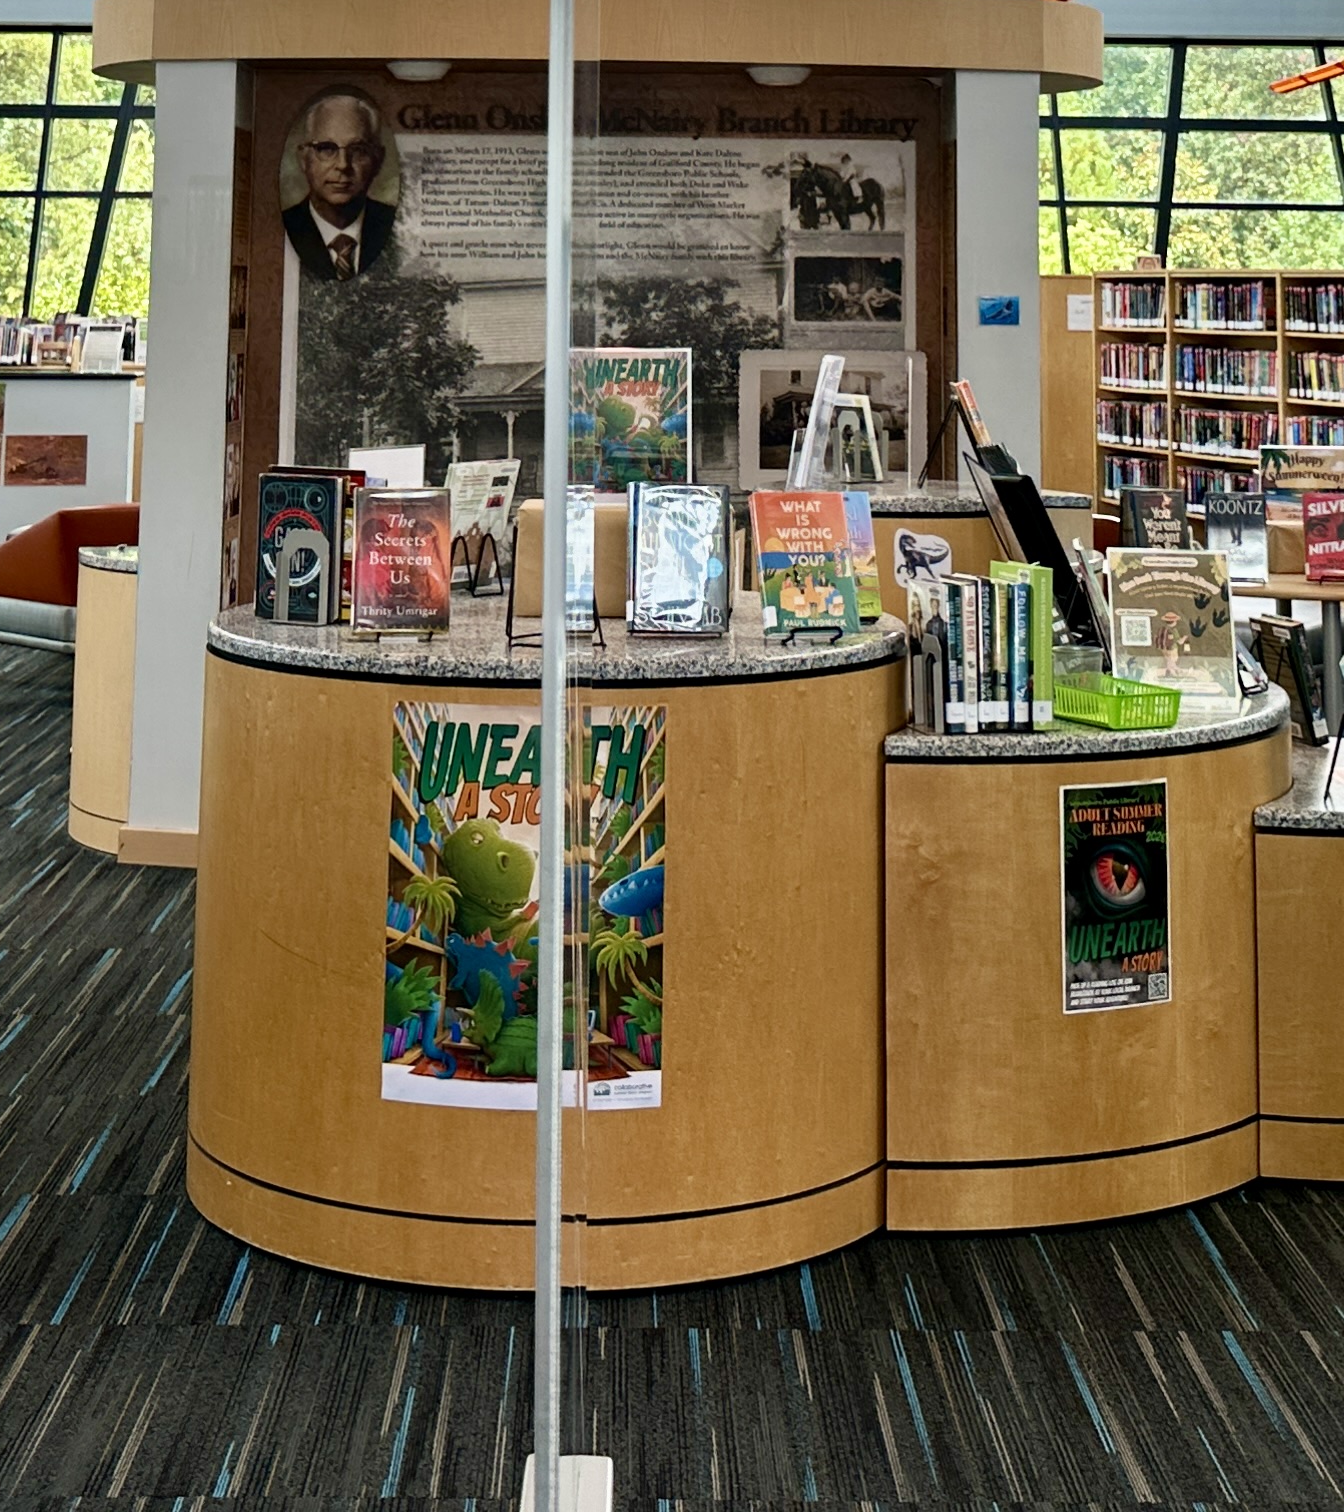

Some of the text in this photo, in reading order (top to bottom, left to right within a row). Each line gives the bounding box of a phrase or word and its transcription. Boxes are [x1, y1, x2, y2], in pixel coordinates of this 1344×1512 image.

[397, 105, 479, 130] Glenn
[716, 105, 810, 133] Branch
[819, 108, 919, 142] Library
[1290, 451, 1324, 468] Happy
[779, 500, 822, 514] WHAT
[1208, 498, 1263, 516] KOONTZ
[387, 513, 416, 529] The
[795, 513, 810, 527] IS
[374, 531, 427, 547] Secrets
[775, 526, 833, 540] WRONG
[785, 540, 825, 553] WITH
[369, 550, 433, 566] Between
[787, 554, 826, 567] YOU?
[389, 569, 411, 585] Us
[361, 604, 439, 619] Thrity Umrigar
[981, 585, 991, 655] STEPHEN KING
[783, 618, 848, 627] PAUL RUDNICK
[966, 595, 976, 653] SO FAR GONE
[1017, 590, 1027, 664] FOLLOW ME
[419, 720, 647, 806] UNEATH
[453, 781, 481, 822] A
[1069, 802, 1163, 824] ADULT SUMMER
[1092, 819, 1146, 837] READING
[1069, 918, 1166, 964] UNEARTH
[1121, 949, 1164, 973] A STORY
